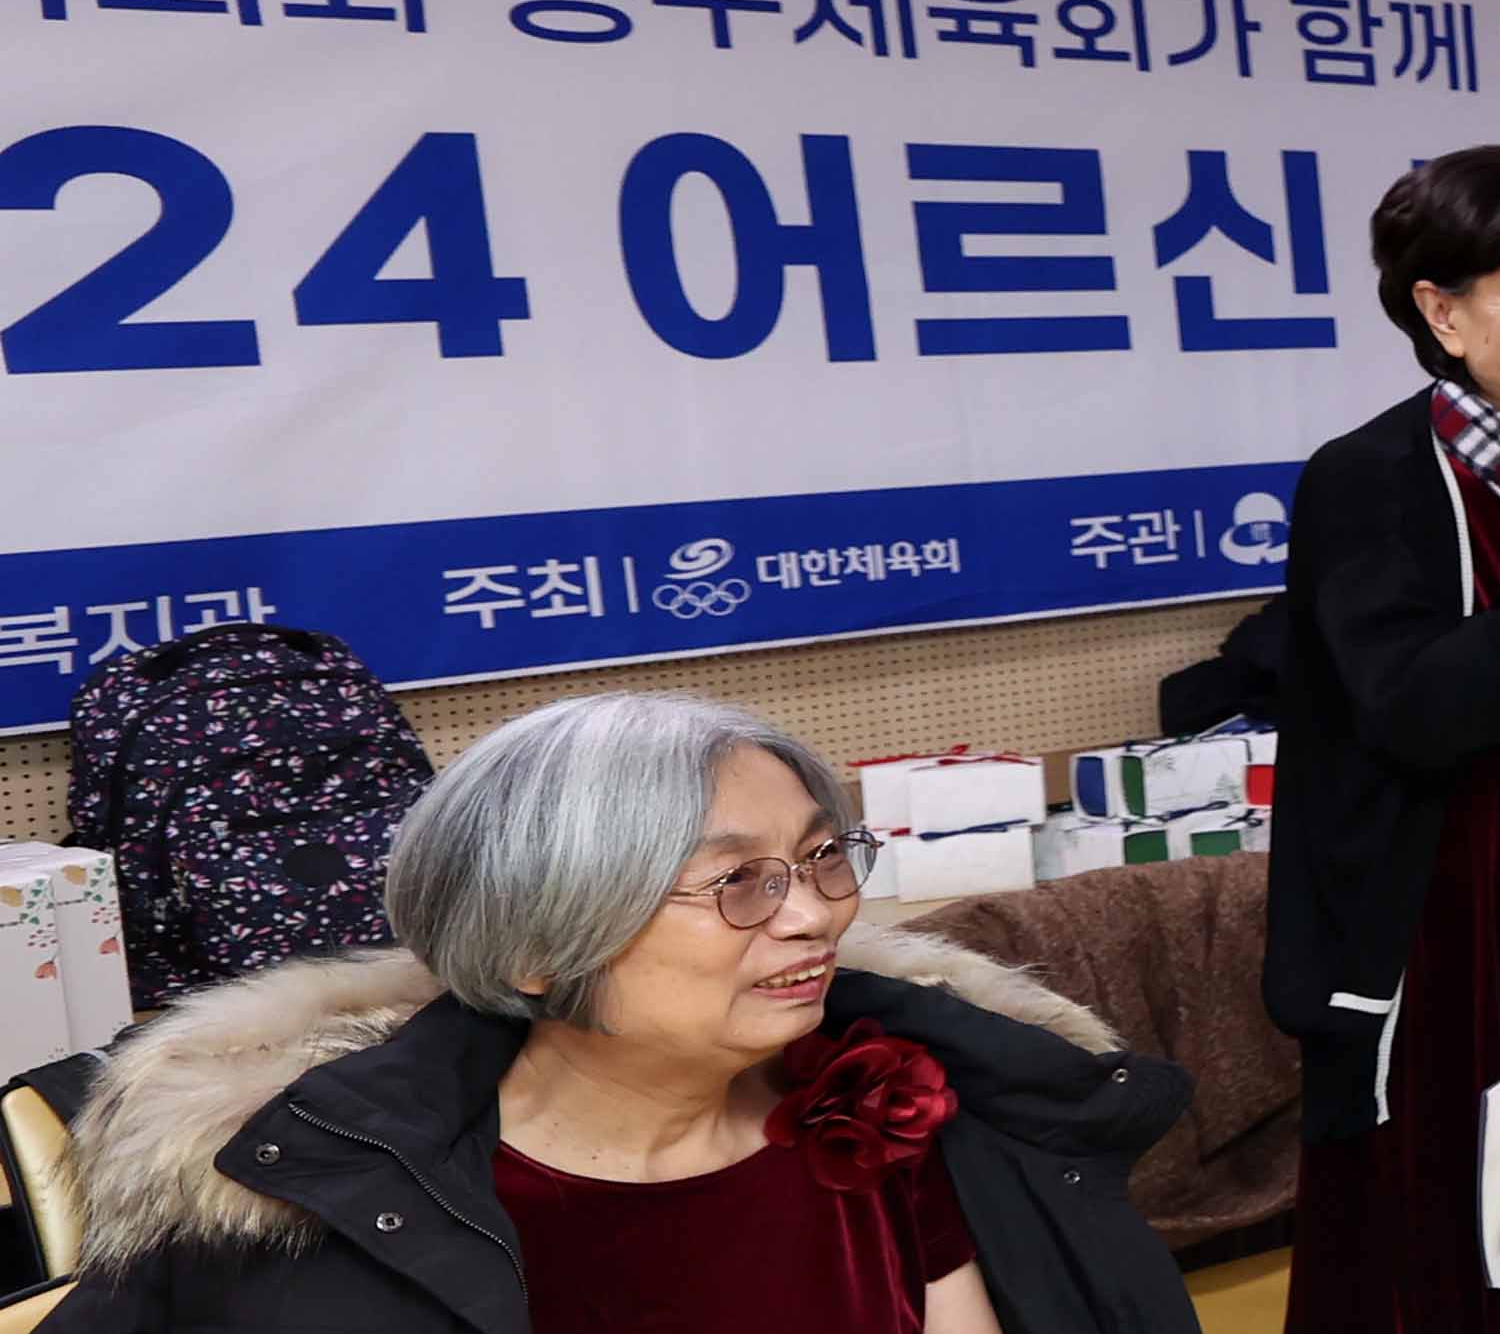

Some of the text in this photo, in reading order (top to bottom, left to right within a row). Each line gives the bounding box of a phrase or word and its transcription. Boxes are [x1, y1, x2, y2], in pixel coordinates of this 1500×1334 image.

[618, 131, 1338, 363] 어르신
[441, 555, 607, 630] 주최
[754, 538, 962, 591] 대한체육회
[1070, 507, 1182, 569] 주관
